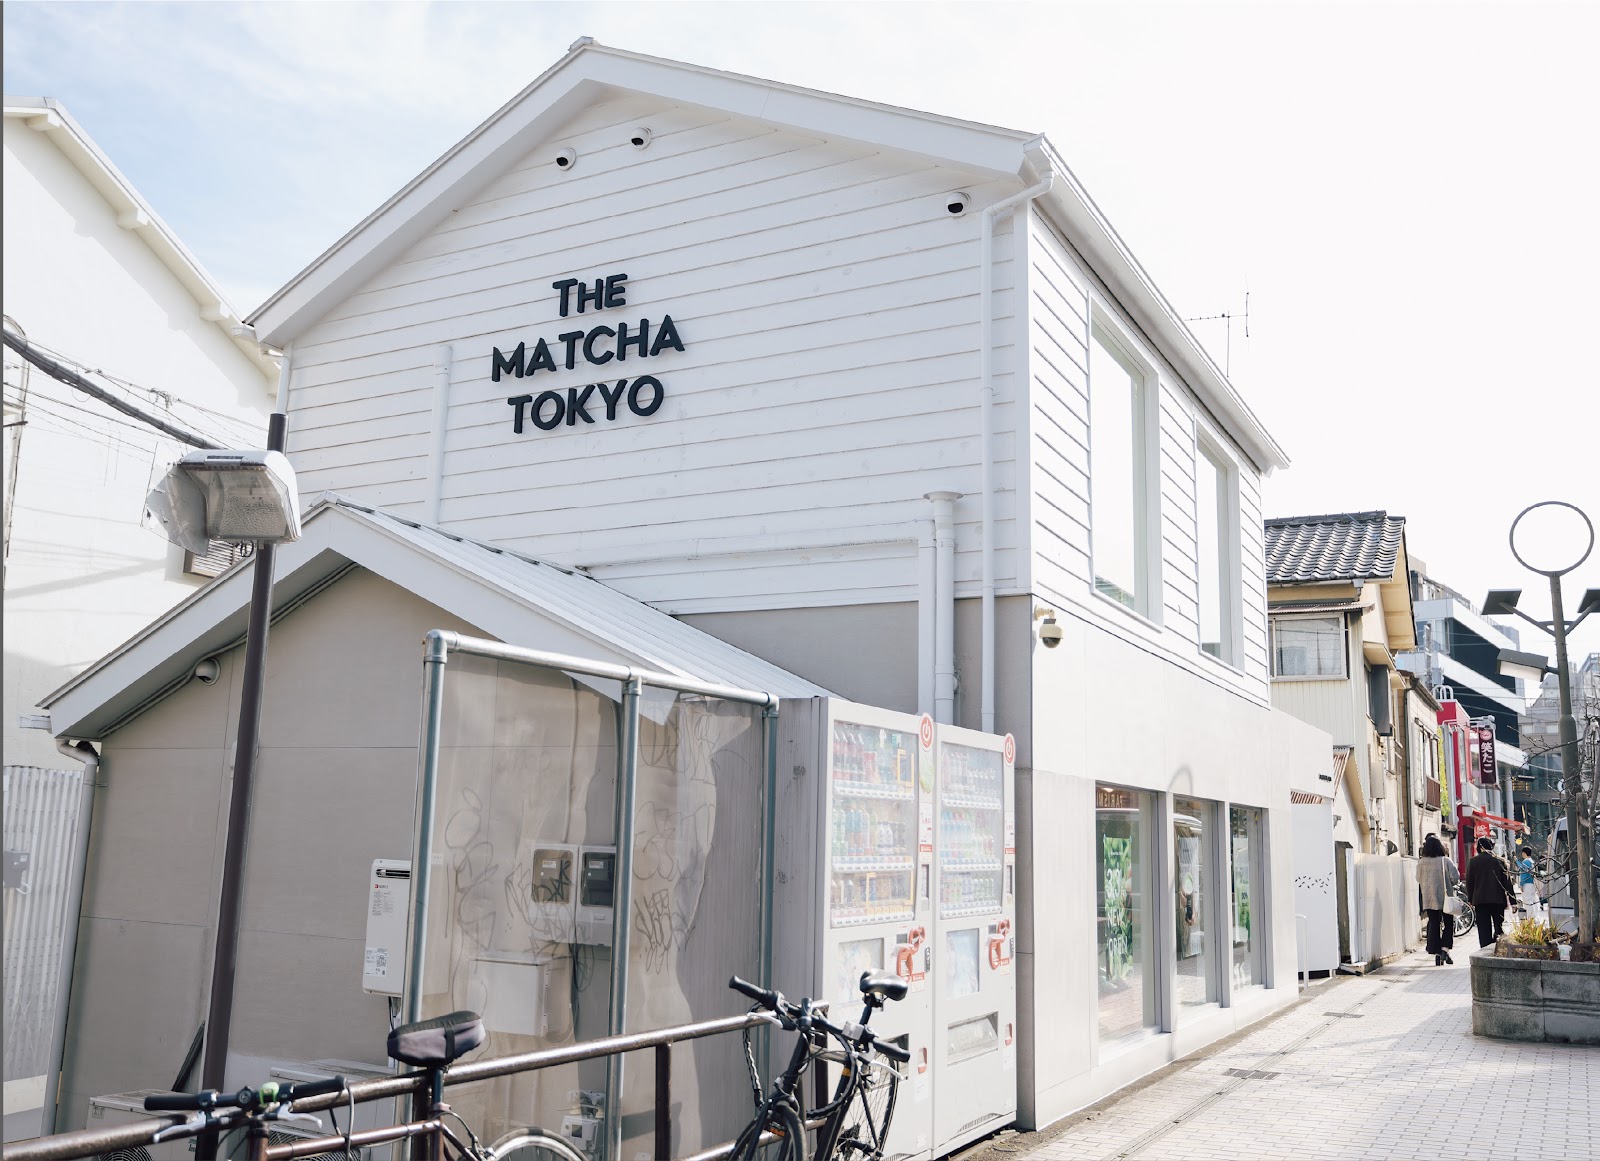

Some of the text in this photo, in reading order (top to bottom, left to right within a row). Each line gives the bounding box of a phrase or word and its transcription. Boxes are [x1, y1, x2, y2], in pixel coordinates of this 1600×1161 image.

[552, 273, 628, 317] THE
[491, 314, 685, 382] MATCHA
[507, 375, 664, 434] TOKYO
[1480, 741, 1493, 773] 笑たこ
